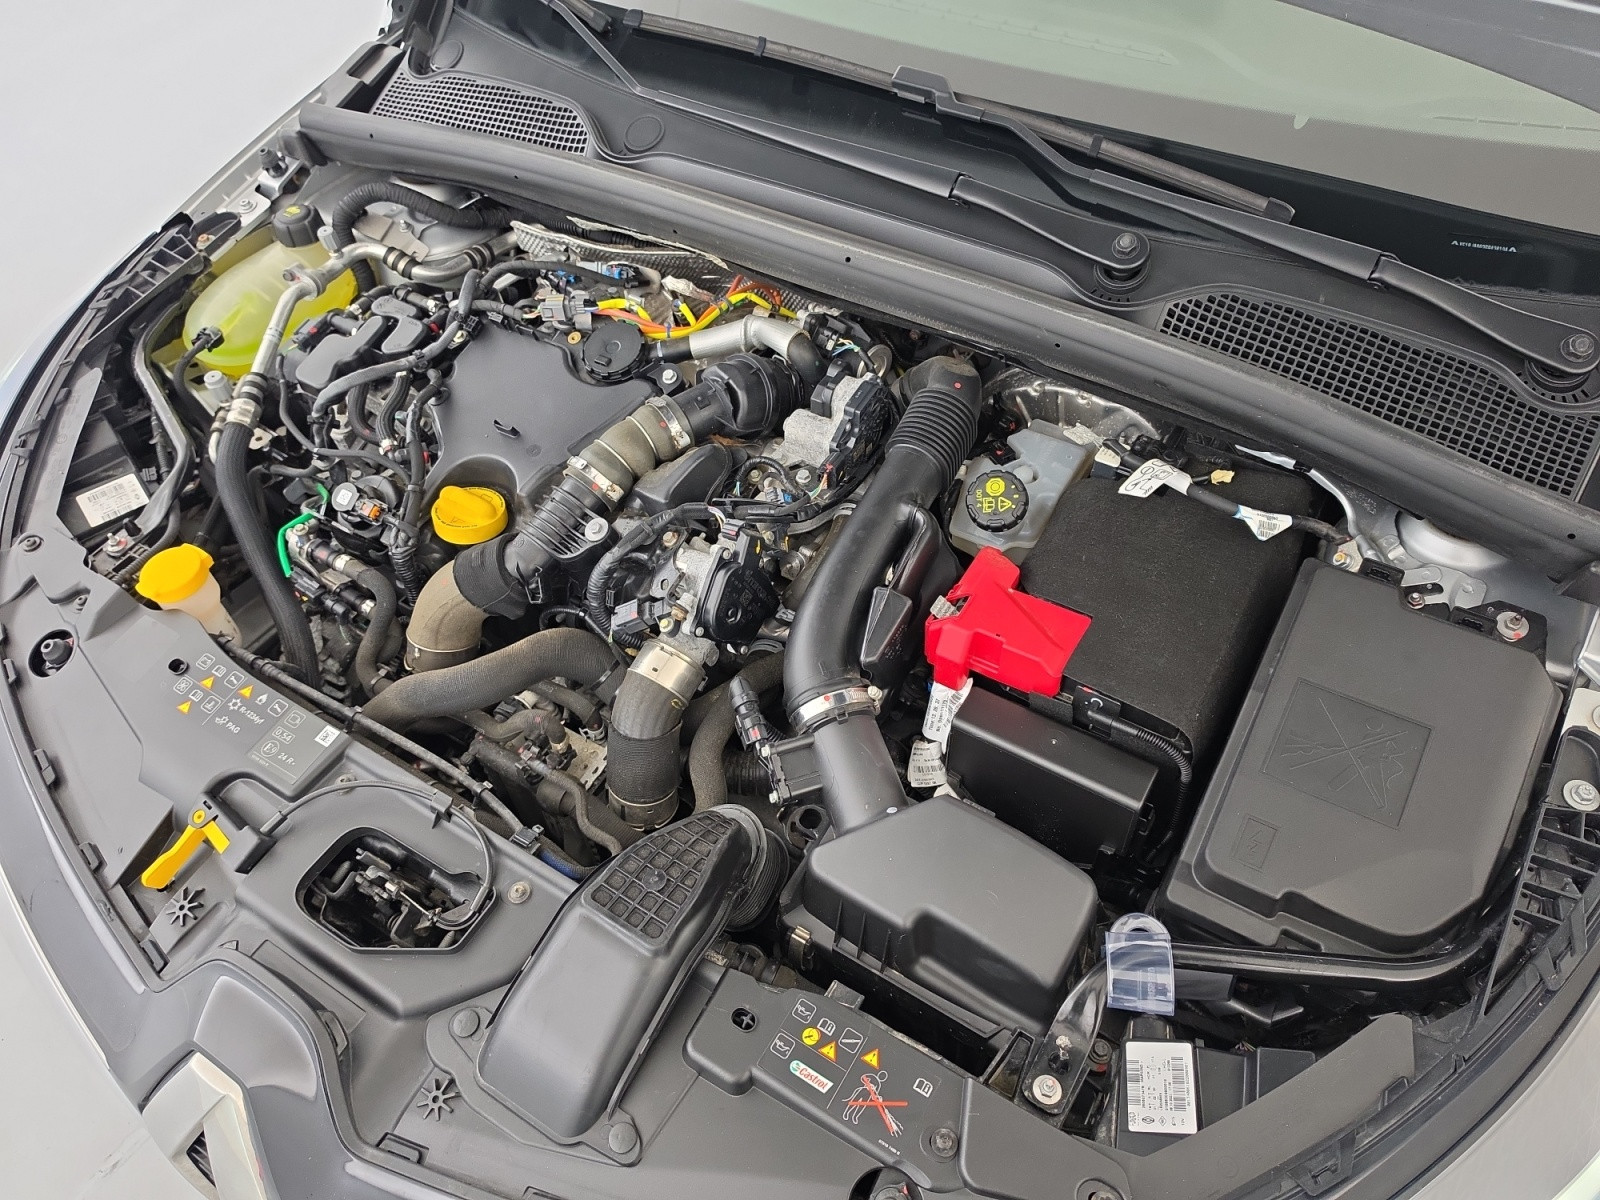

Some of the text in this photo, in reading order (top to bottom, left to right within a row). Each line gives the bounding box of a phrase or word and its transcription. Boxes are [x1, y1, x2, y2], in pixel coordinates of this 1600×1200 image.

[239, 706, 265, 724] R-1234yf
[226, 722, 241, 733] PAG
[799, 1067, 828, 1090] Castrol
